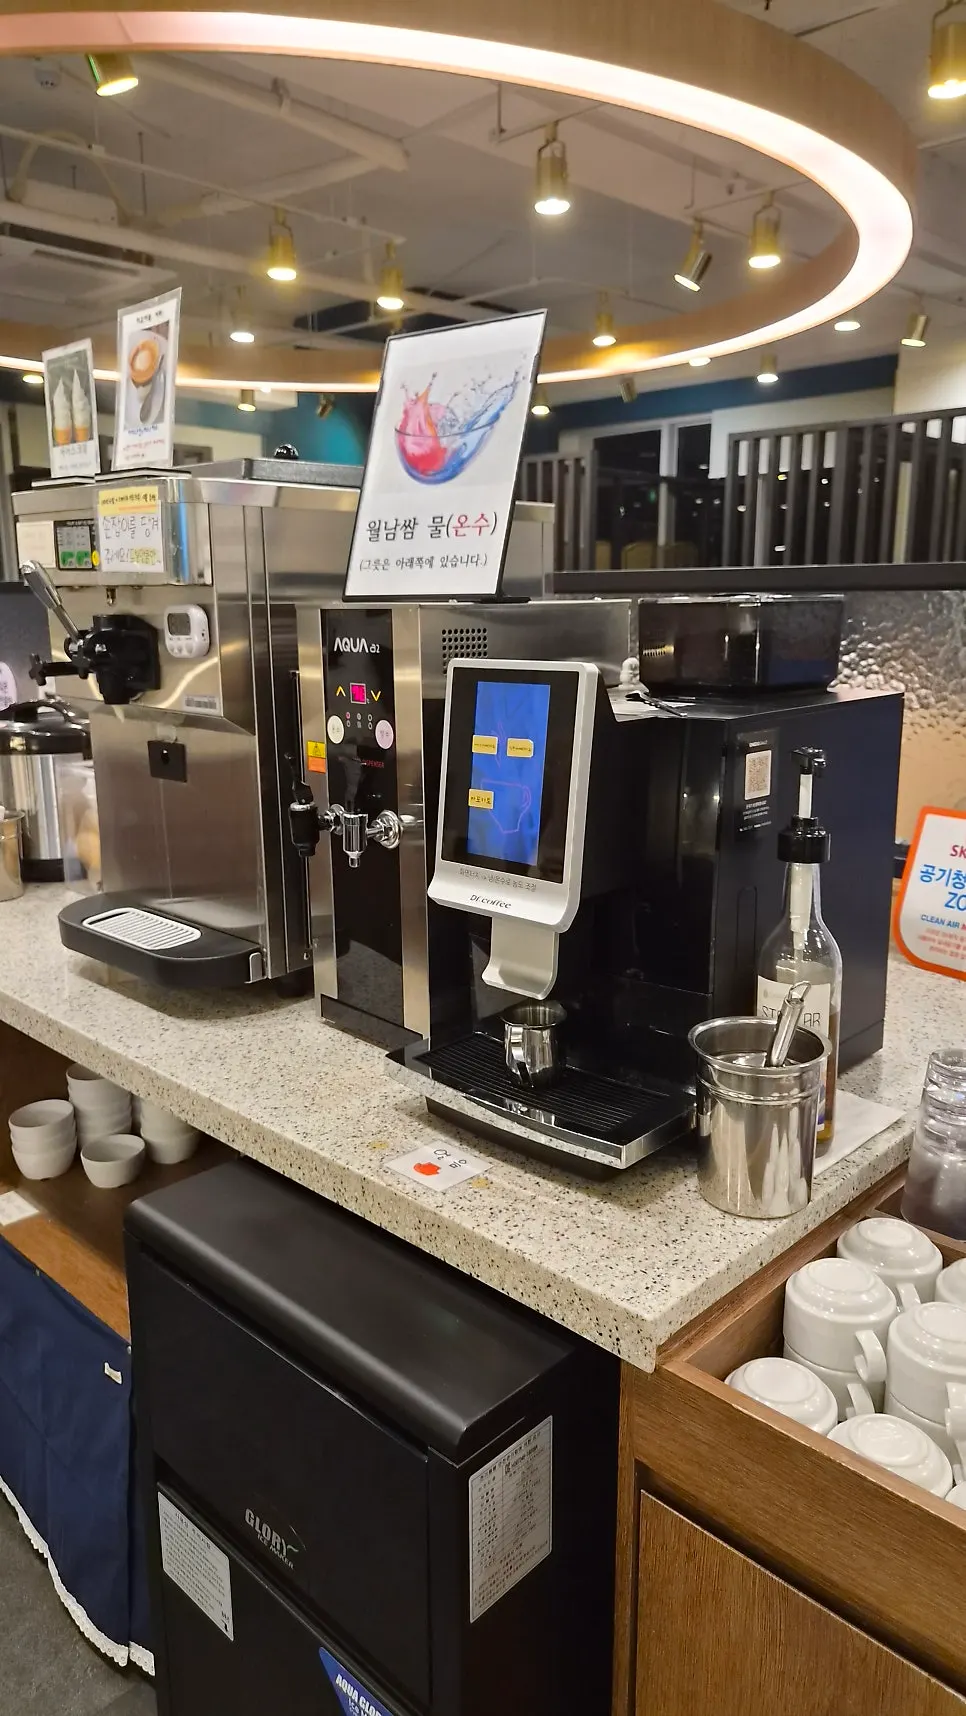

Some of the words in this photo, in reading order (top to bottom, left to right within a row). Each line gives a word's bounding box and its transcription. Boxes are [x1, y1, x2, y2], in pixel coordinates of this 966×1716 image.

[366, 516, 419, 542] 월남쌈
[427, 512, 498, 539] 물(온수)
[359, 559, 391, 572] (그릇은
[395, 555, 435, 570] 아래쪽에
[439, 553, 488, 568] 있습니다.)
[334, 637, 369, 653] AQUA
[950, 845, 966, 859] SK
[920, 864, 966, 890] 공기청
[920, 914, 946, 926] CLEAN
[946, 920, 960, 929] AIR
[245, 1508, 299, 1557] GLORY
[335, 1673, 359, 1704] AQUA
